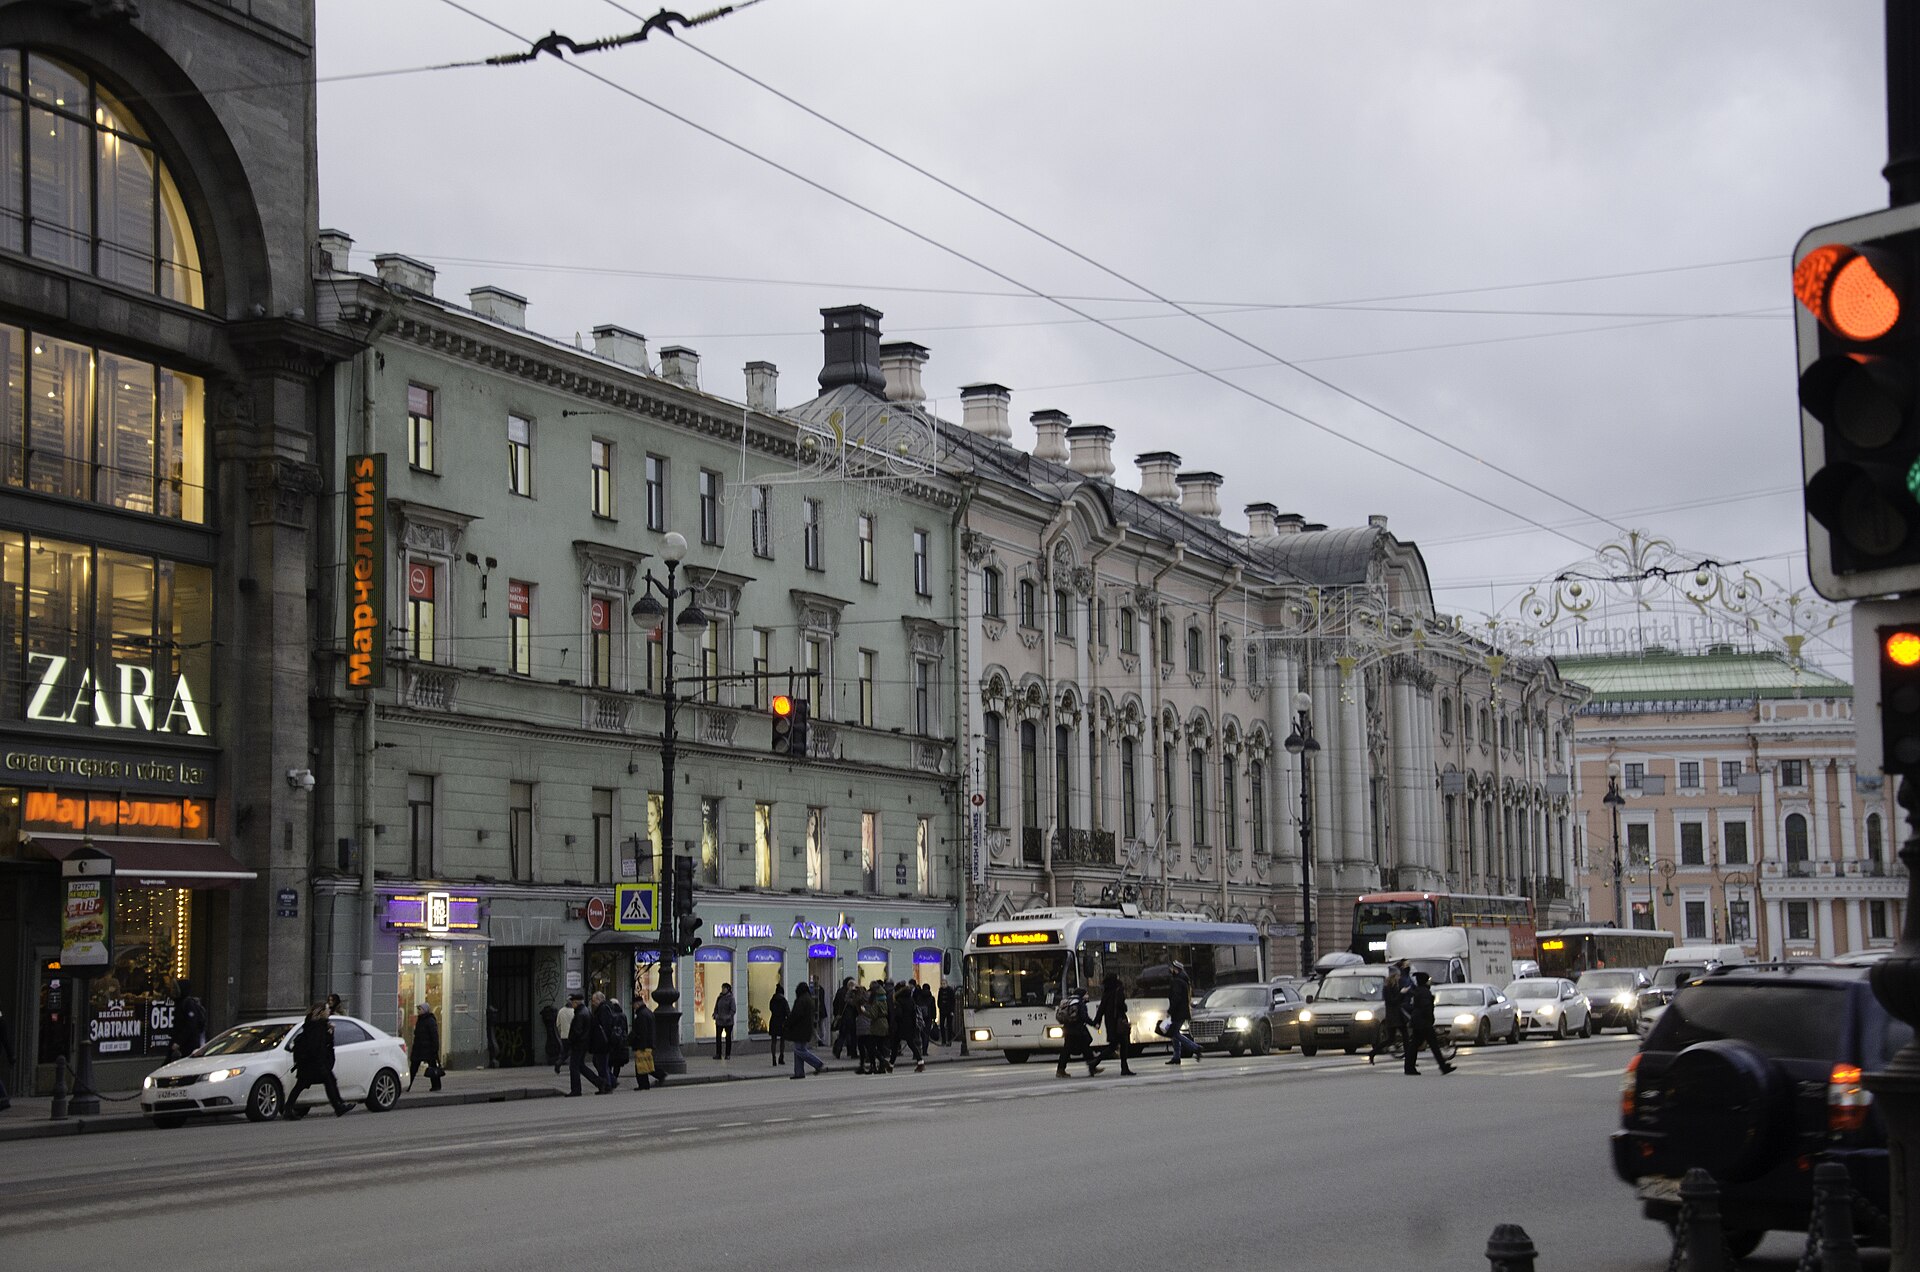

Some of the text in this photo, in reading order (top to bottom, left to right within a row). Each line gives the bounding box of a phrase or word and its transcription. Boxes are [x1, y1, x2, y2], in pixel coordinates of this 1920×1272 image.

[1580, 617, 1682, 650] Imperial
[27, 651, 208, 736] ZARA
[6, 751, 206, 785] спагеттерия wine bar
[713, 923, 774, 938] КОСМЕТИКА
[873, 927, 936, 940] ПАРФЮМЕРИЯ
[98, 1010, 134, 1019] BREAKFAST
[90, 1020, 141, 1041] ЗАВТРАКИ
